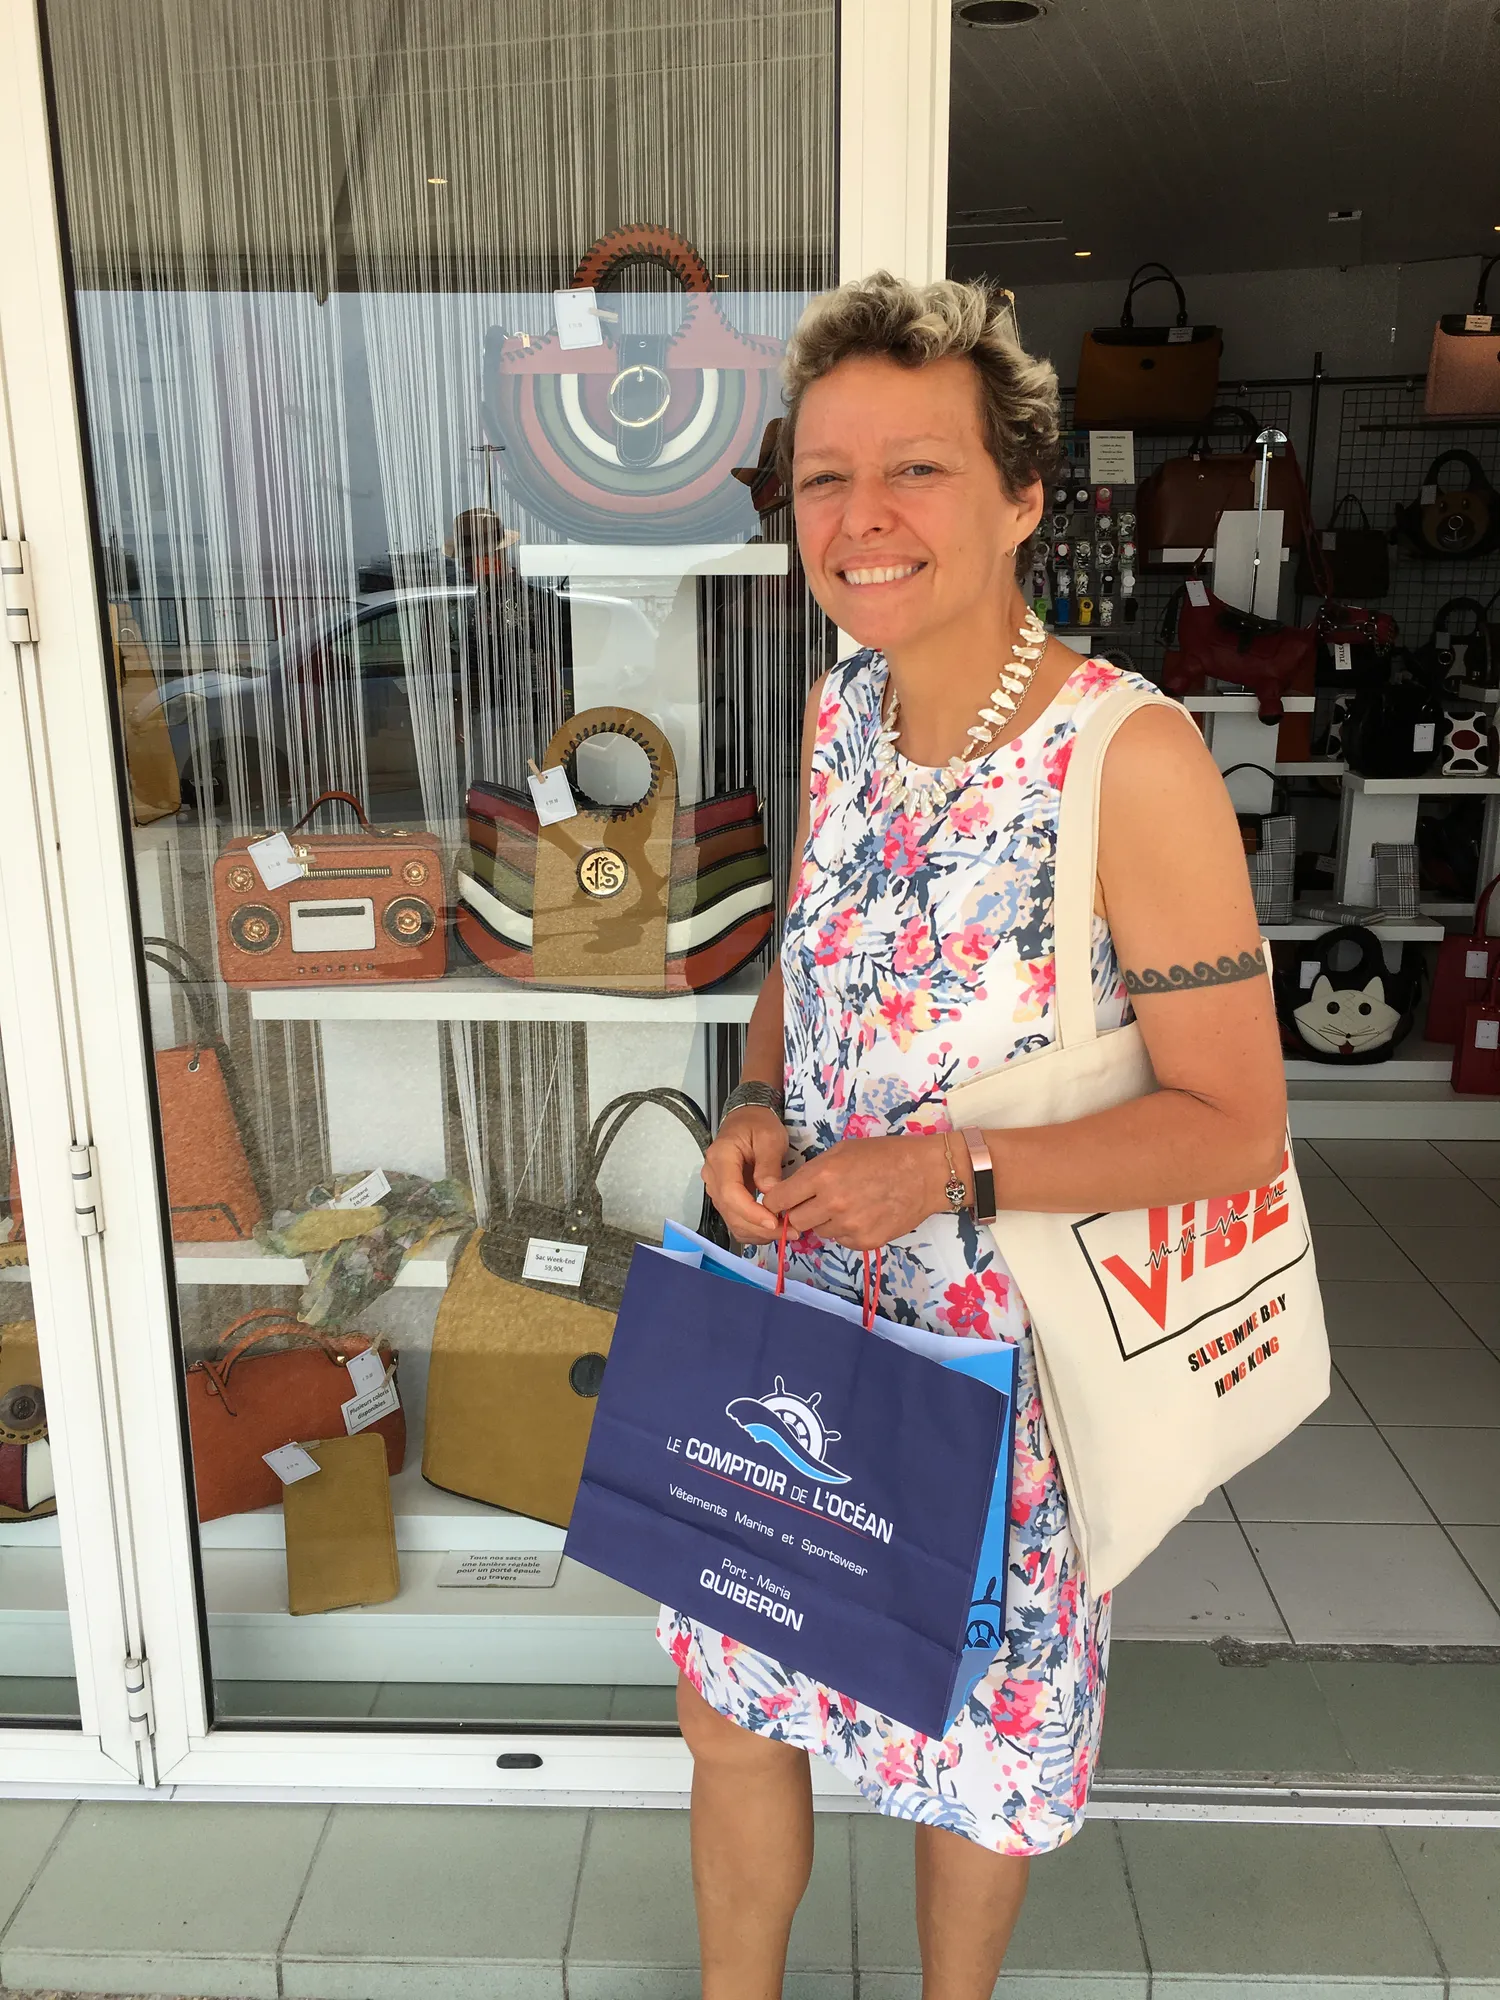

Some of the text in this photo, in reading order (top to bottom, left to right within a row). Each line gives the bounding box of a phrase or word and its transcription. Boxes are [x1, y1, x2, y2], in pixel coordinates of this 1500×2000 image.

[546, 1256, 576, 1265] Week-End
[1188, 1293, 1286, 1372] SILVERMINE BAY
[1214, 1336, 1280, 1398] HONG KONG
[350, 1389, 389, 1415] Plusieurs coloris
[358, 1400, 386, 1419] disponibles
[666, 1436, 894, 1545] LE COMPTOIR DE L'OCÉAN
[669, 1483, 868, 1577] Vêtements Marins et Sportswear
[699, 1568, 804, 1632] QUIBERON
[721, 1558, 747, 1580] Port
[756, 1574, 791, 1601] Maria
